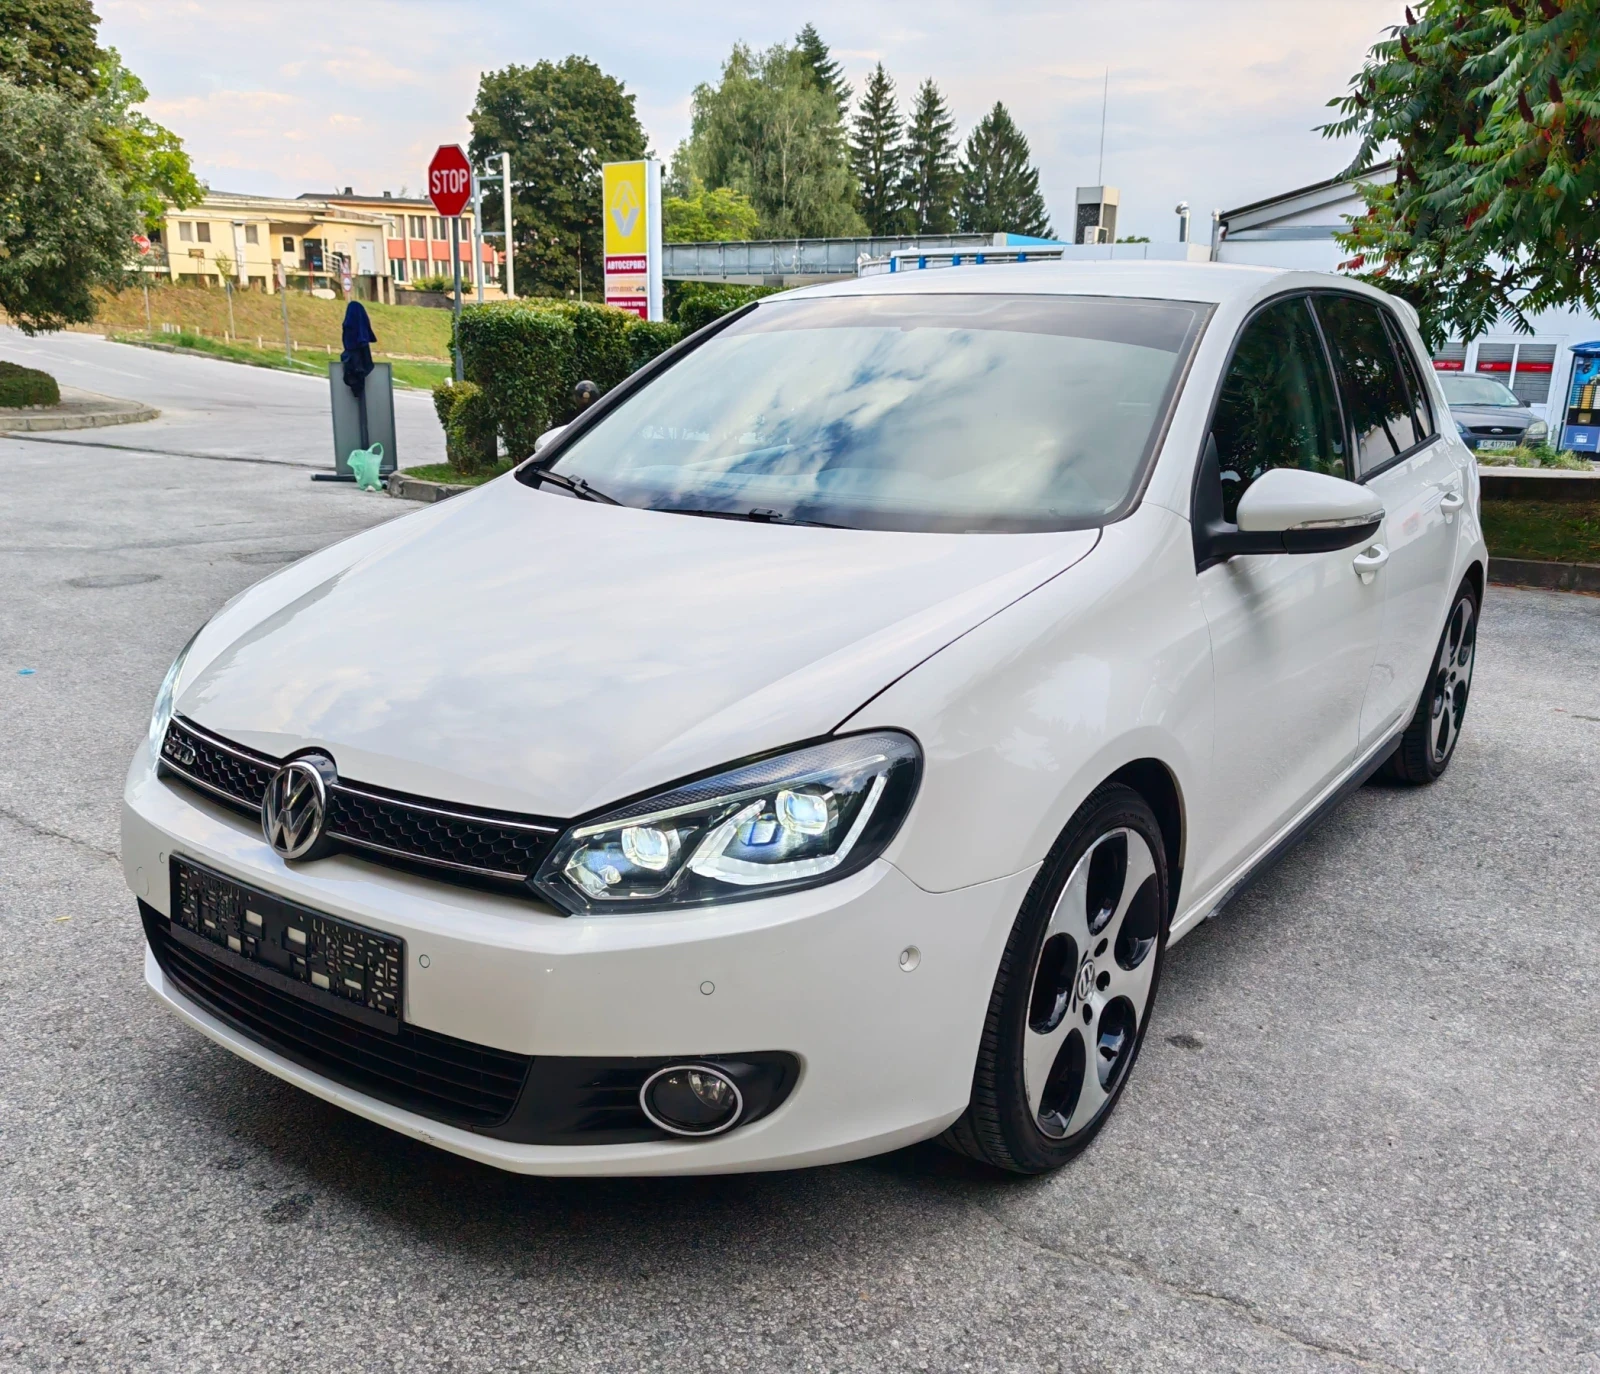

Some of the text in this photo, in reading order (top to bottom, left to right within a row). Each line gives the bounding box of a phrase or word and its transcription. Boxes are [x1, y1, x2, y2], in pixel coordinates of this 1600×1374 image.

[432, 169, 468, 194] STOP
[607, 260, 646, 270] АВТОСЕРВИЗ
[164, 737, 196, 765] GTD
